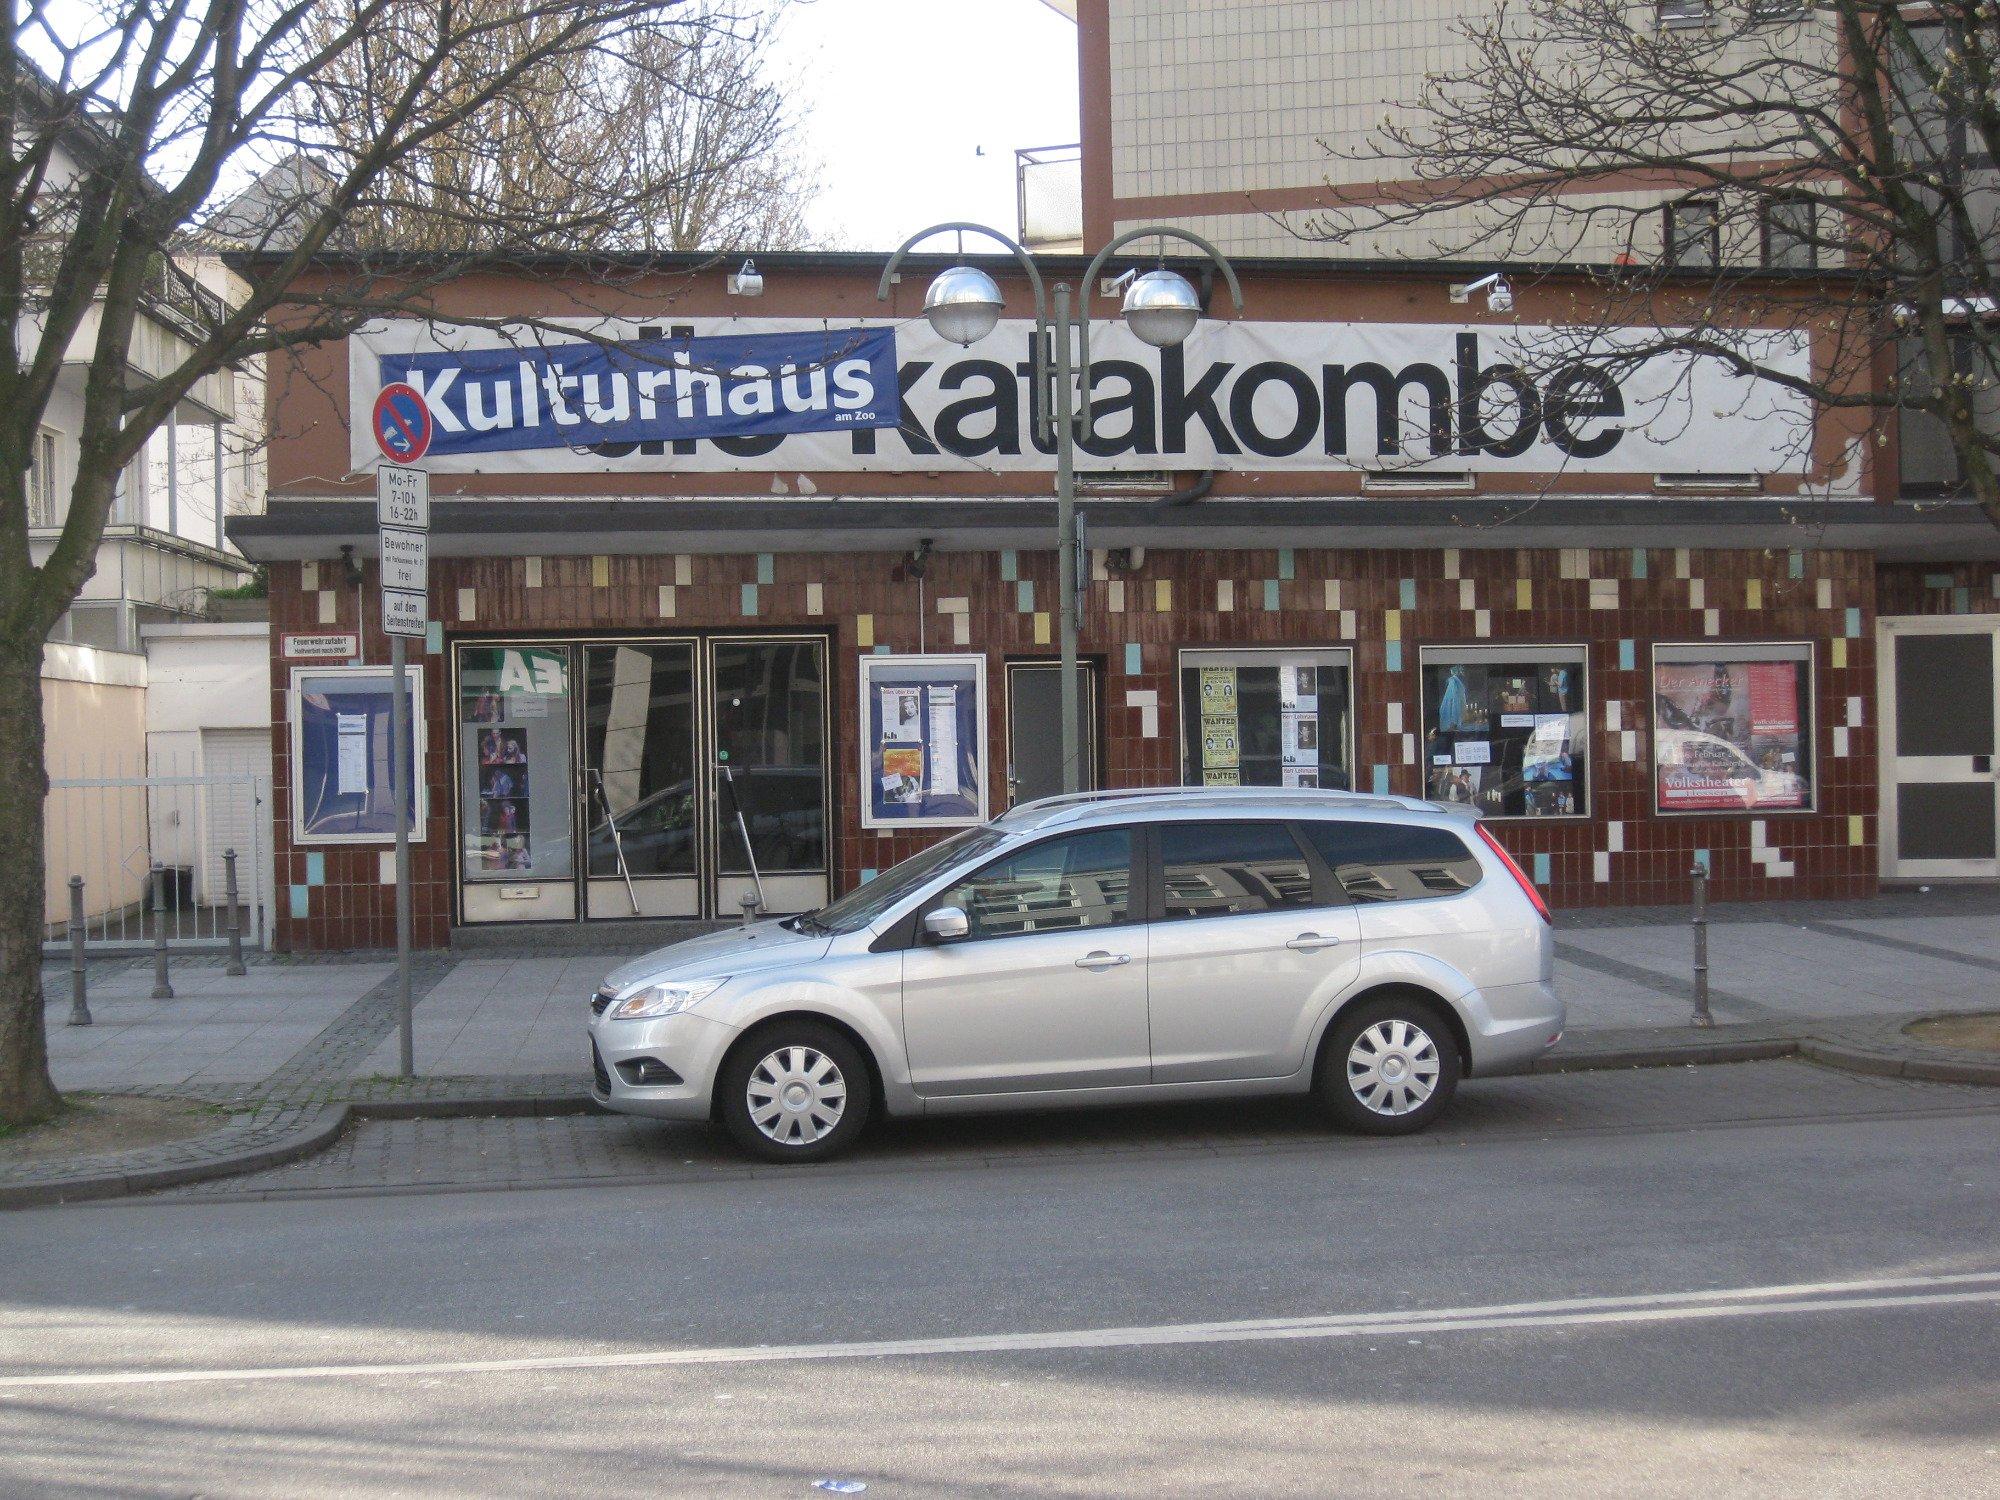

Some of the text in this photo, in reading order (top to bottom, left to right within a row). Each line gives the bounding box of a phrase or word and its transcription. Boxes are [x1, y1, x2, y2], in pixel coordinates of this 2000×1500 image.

[406, 349, 875, 433] Kulturhaus
[835, 411, 876, 421] am Zoo
[388, 472, 418, 488] Mo-Fr
[384, 537, 424, 553] Bewohner
[397, 569, 412, 582] frei
[393, 601, 418, 613] auf dem
[386, 614, 425, 630] Seitenstreifen
[293, 637, 347, 646] Feuerwehrzufahrt
[1695, 749, 1724, 758] Februar
[1206, 772, 1238, 780] WANTED
[1665, 776, 1747, 789] Volkstheater
